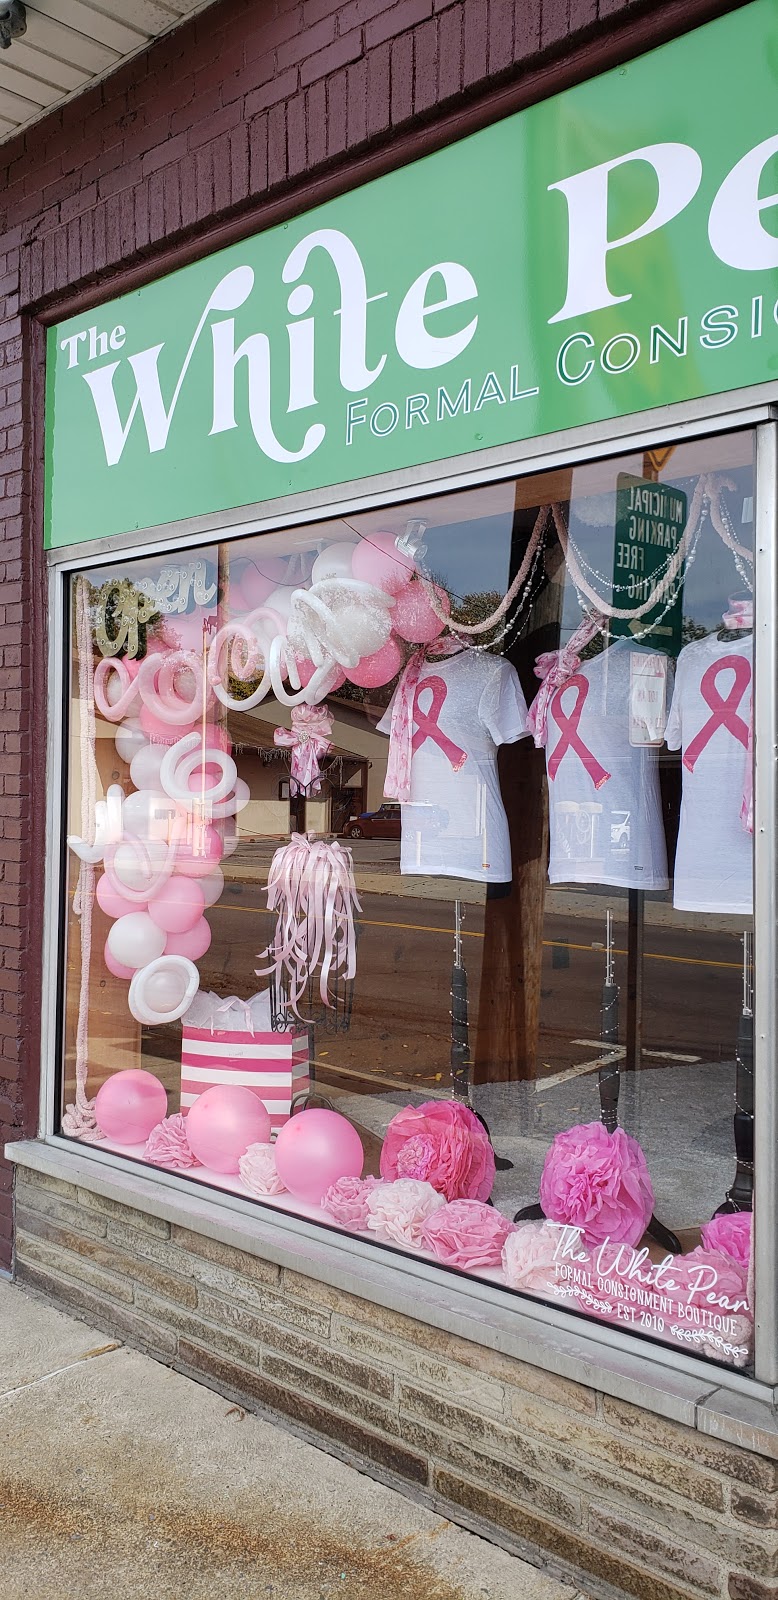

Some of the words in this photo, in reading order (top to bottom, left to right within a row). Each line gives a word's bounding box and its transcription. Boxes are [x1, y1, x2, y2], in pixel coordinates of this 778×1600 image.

[61, 325, 126, 369] The
[82, 228, 479, 466] White
[556, 296, 778, 386] CONSI
[96, 559, 217, 660] Open
[547, 1223, 590, 1262] The
[597, 1236, 682, 1290] White
[688, 1265, 750, 1312] Pear
[555, 1262, 594, 1288] FORMAL
[597, 1277, 673, 1314] CONSIGNMENT
[678, 1302, 737, 1336] BOUTIQUE
[617, 1303, 636, 1322] EST
[640, 1310, 665, 1332] 2010
